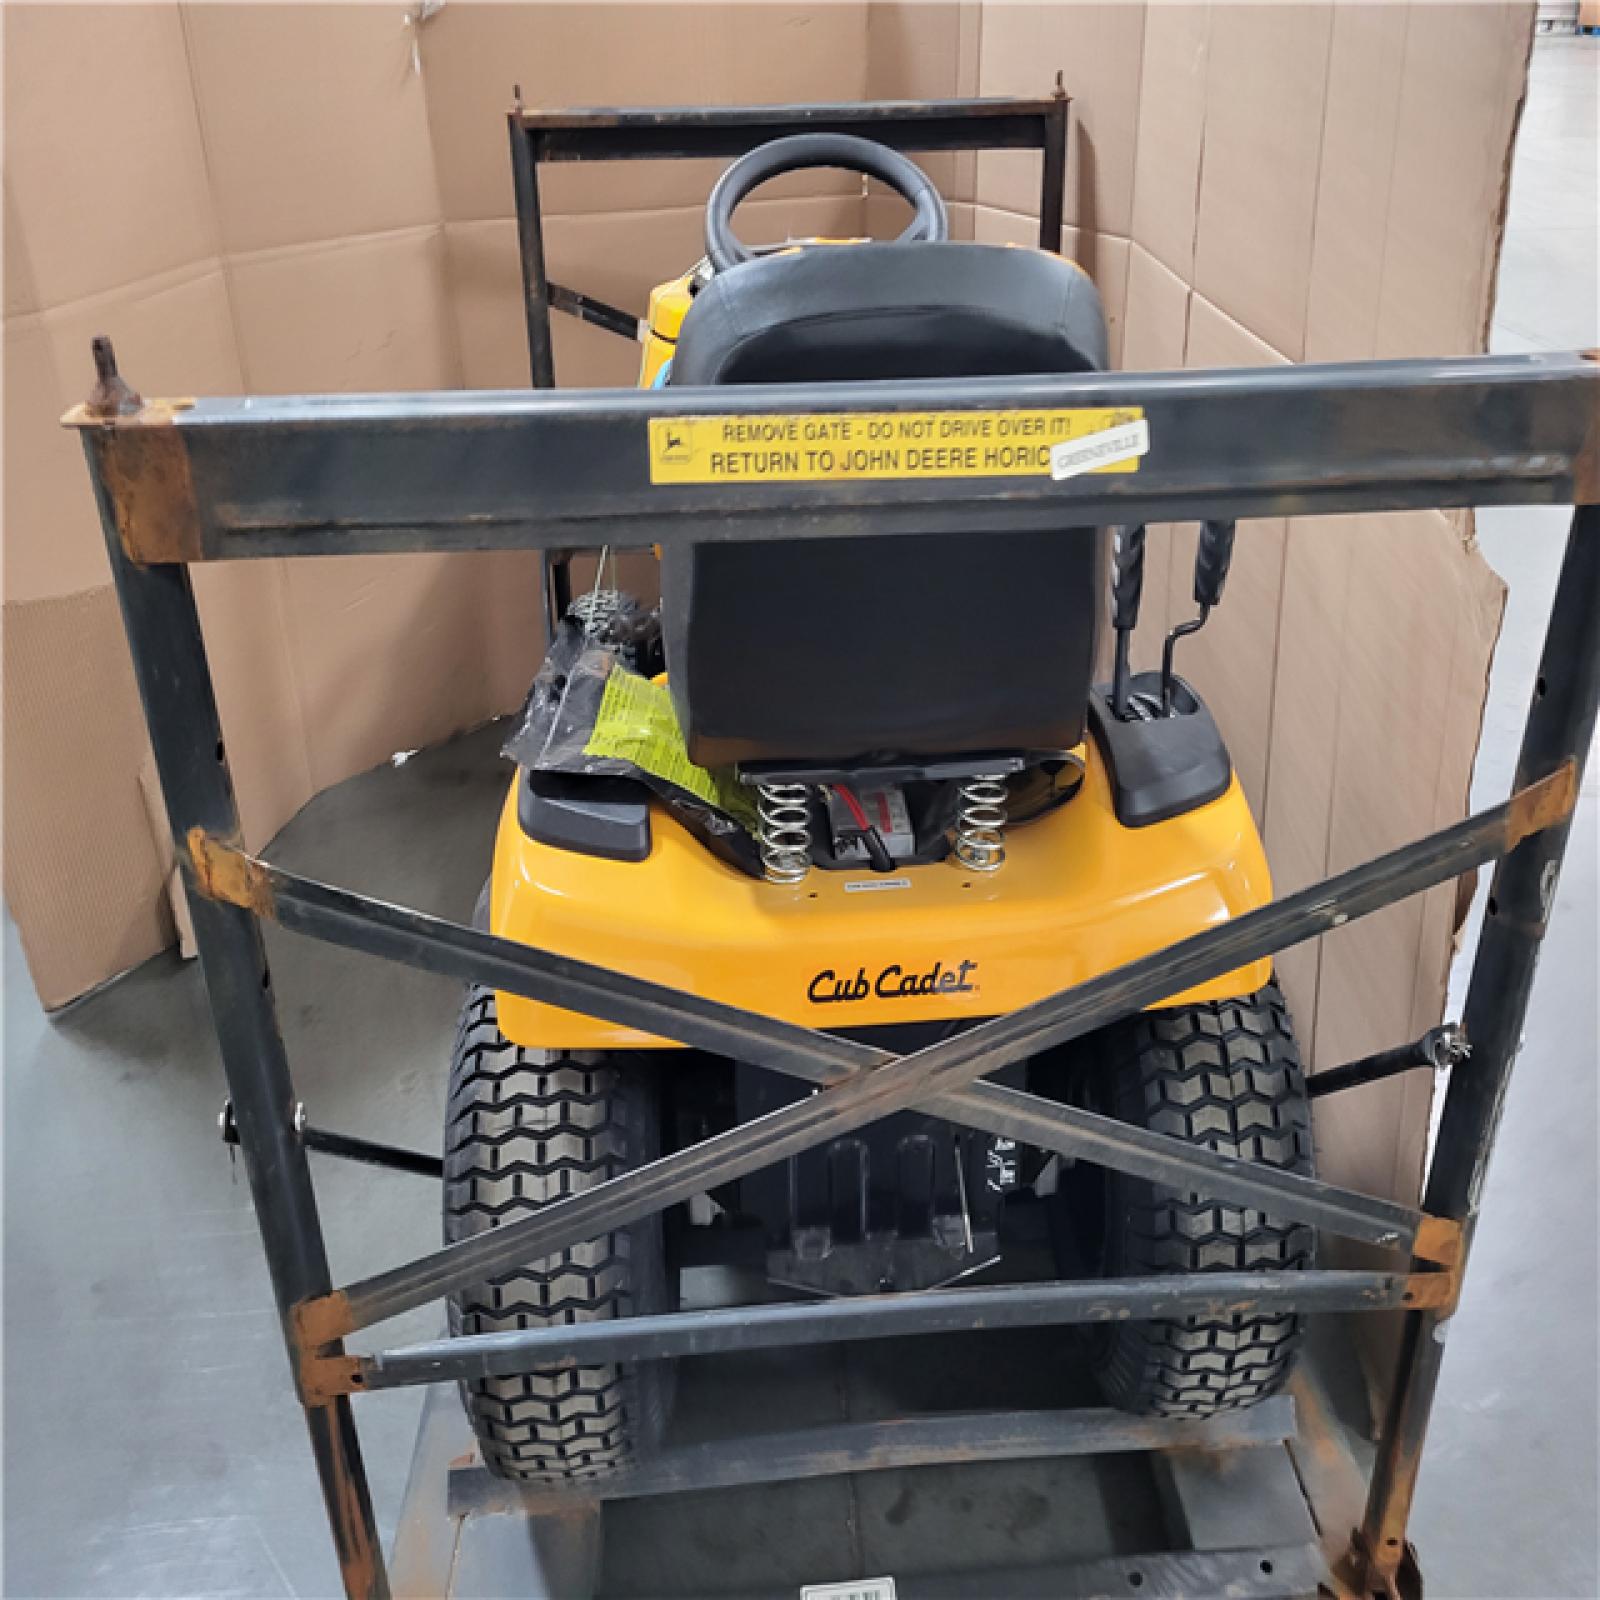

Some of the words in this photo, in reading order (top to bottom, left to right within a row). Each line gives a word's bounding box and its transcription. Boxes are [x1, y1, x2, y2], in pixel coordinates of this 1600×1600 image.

[723, 423, 798, 441] REMOVE
[804, 421, 852, 441] GATE
[867, 421, 893, 440] DO
[899, 418, 935, 438] NOT
[940, 418, 993, 438] DRIVE
[999, 417, 1046, 436] OVER
[1051, 416, 1071, 435] IT!
[711, 451, 799, 474] RETURN
[806, 450, 834, 472] TO
[839, 449, 899, 471] JOHN
[905, 447, 977, 470] DEERE
[984, 444, 1051, 468] HORIC
[807, 967, 870, 1003] Cub
[875, 959, 978, 998] Cadet
